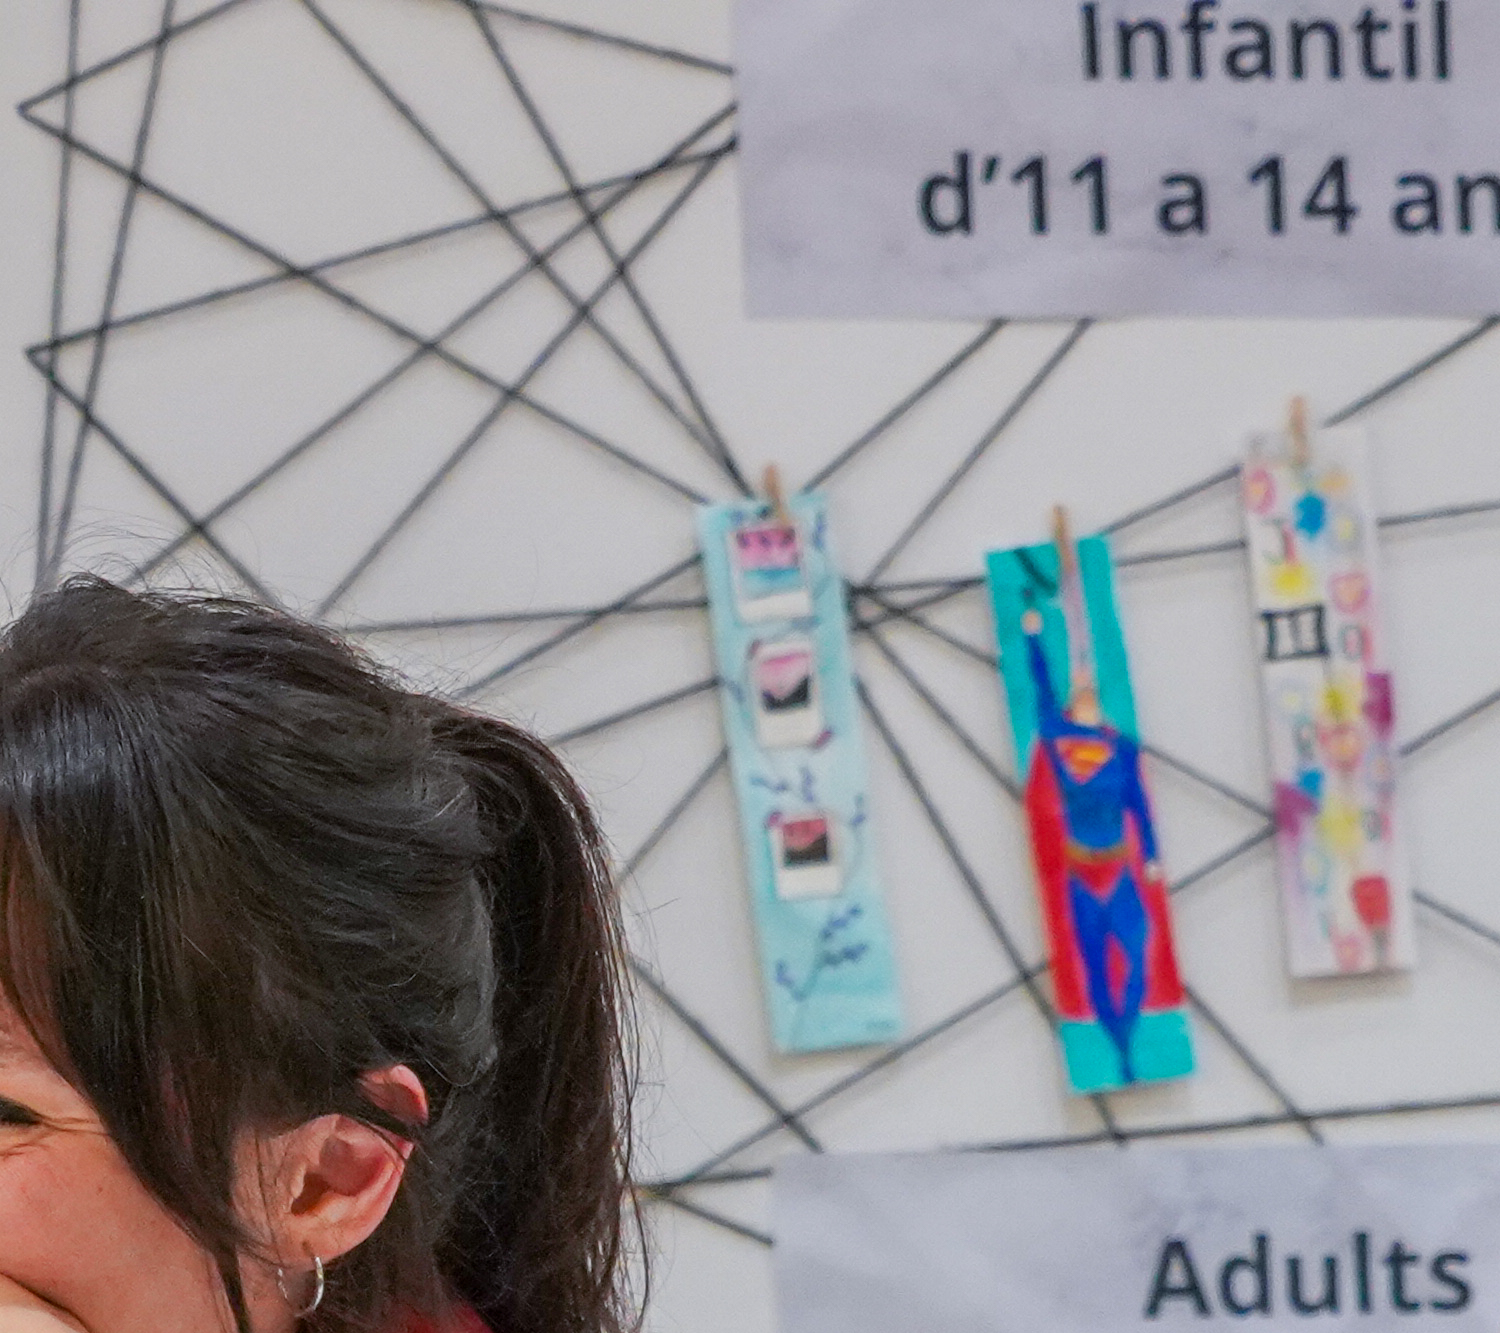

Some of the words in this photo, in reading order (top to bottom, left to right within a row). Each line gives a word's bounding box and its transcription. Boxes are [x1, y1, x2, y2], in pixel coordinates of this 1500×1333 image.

[1080, 0, 1453, 82] Infantil
[1155, 171, 1210, 238] a
[1246, 154, 1361, 237] 14
[1143, 1229, 1473, 1319] Adults
